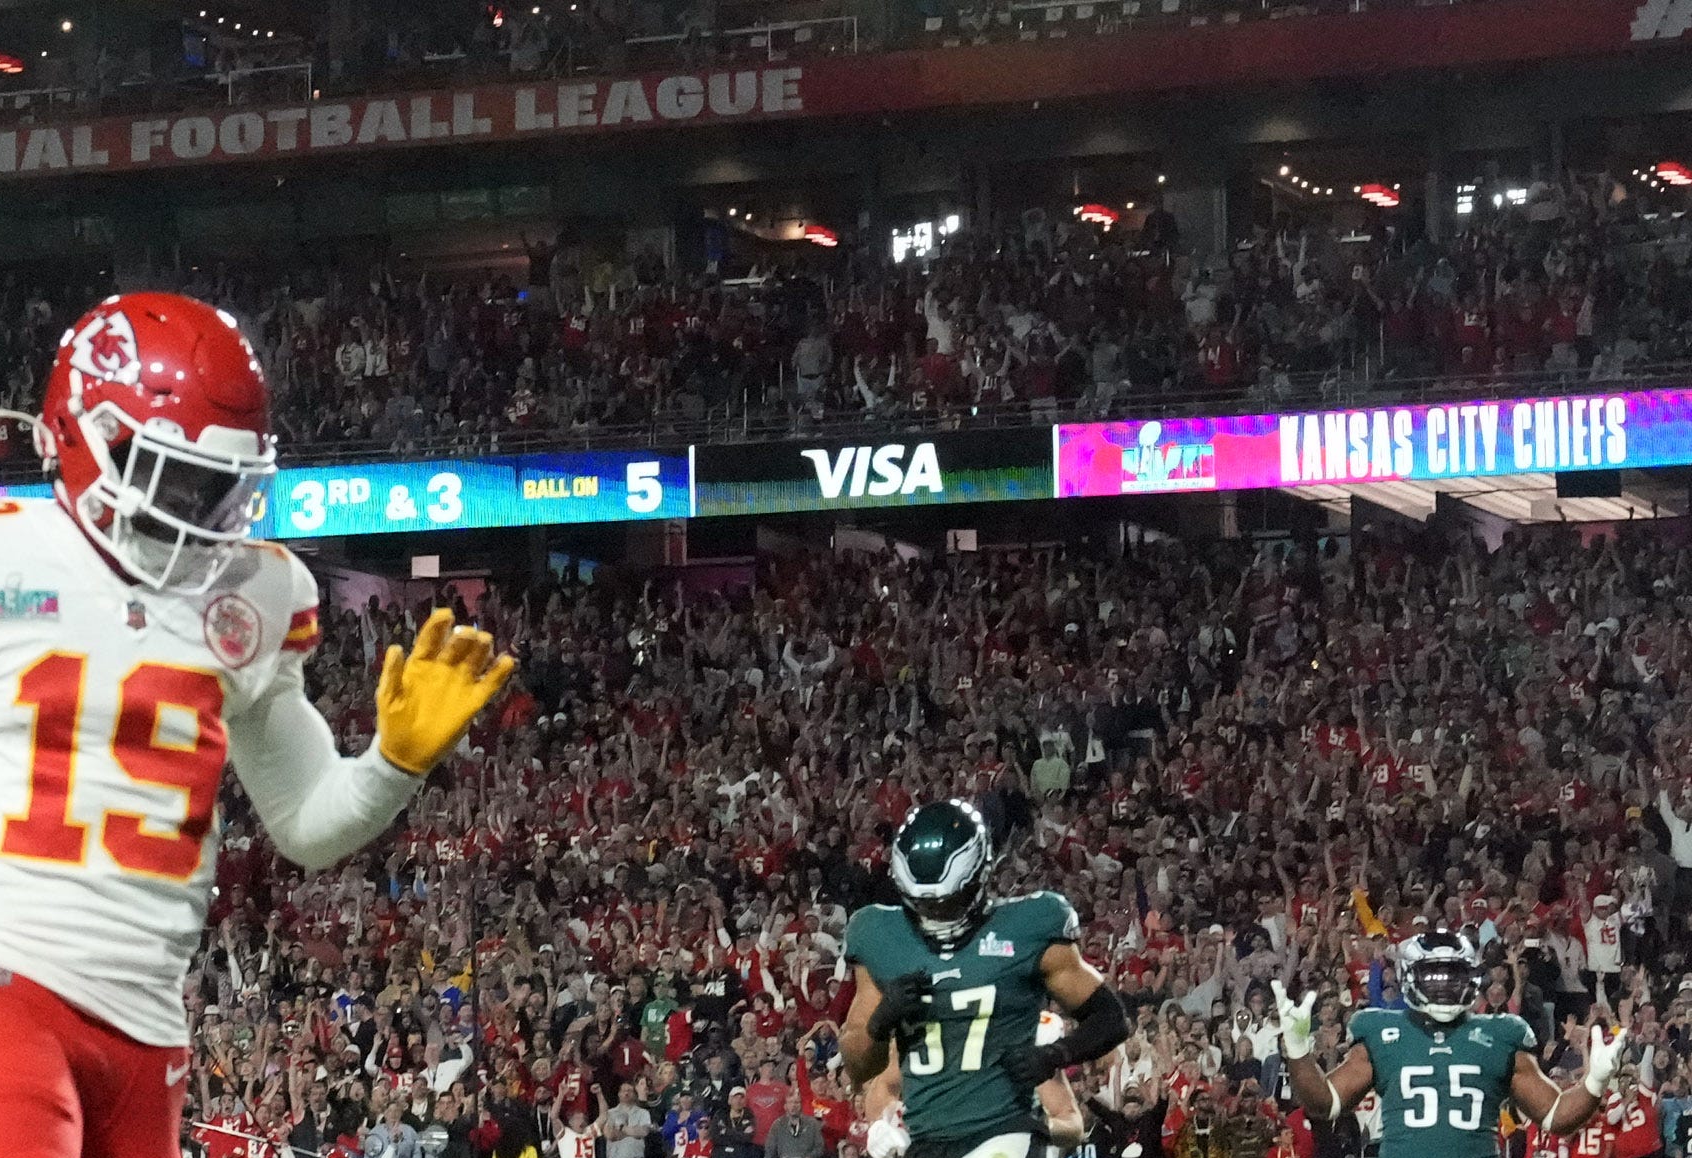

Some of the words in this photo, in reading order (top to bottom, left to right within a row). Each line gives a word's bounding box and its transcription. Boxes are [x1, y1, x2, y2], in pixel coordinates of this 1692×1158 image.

[129, 93, 492, 163] FOOTBALL
[514, 67, 804, 132] LEAGUE
[1279, 409, 1413, 482] KANSAS
[1426, 404, 1500, 474] CITY
[1512, 397, 1627, 470] CHIEFS
[523, 479, 571, 500] BALL
[573, 476, 599, 497] ON
[626, 461, 662, 513] 5
[801, 442, 943, 498] VISA
[292, 478, 370, 531] 3RD
[385, 485, 418, 521] &
[427, 472, 463, 523] 3
[1599, 928, 1617, 945] 15
[1400, 1064, 1484, 1131] 55
[1622, 1101, 1647, 1132] 15
[574, 1136, 595, 1158] 15
[1577, 1128, 1602, 1156] 15
